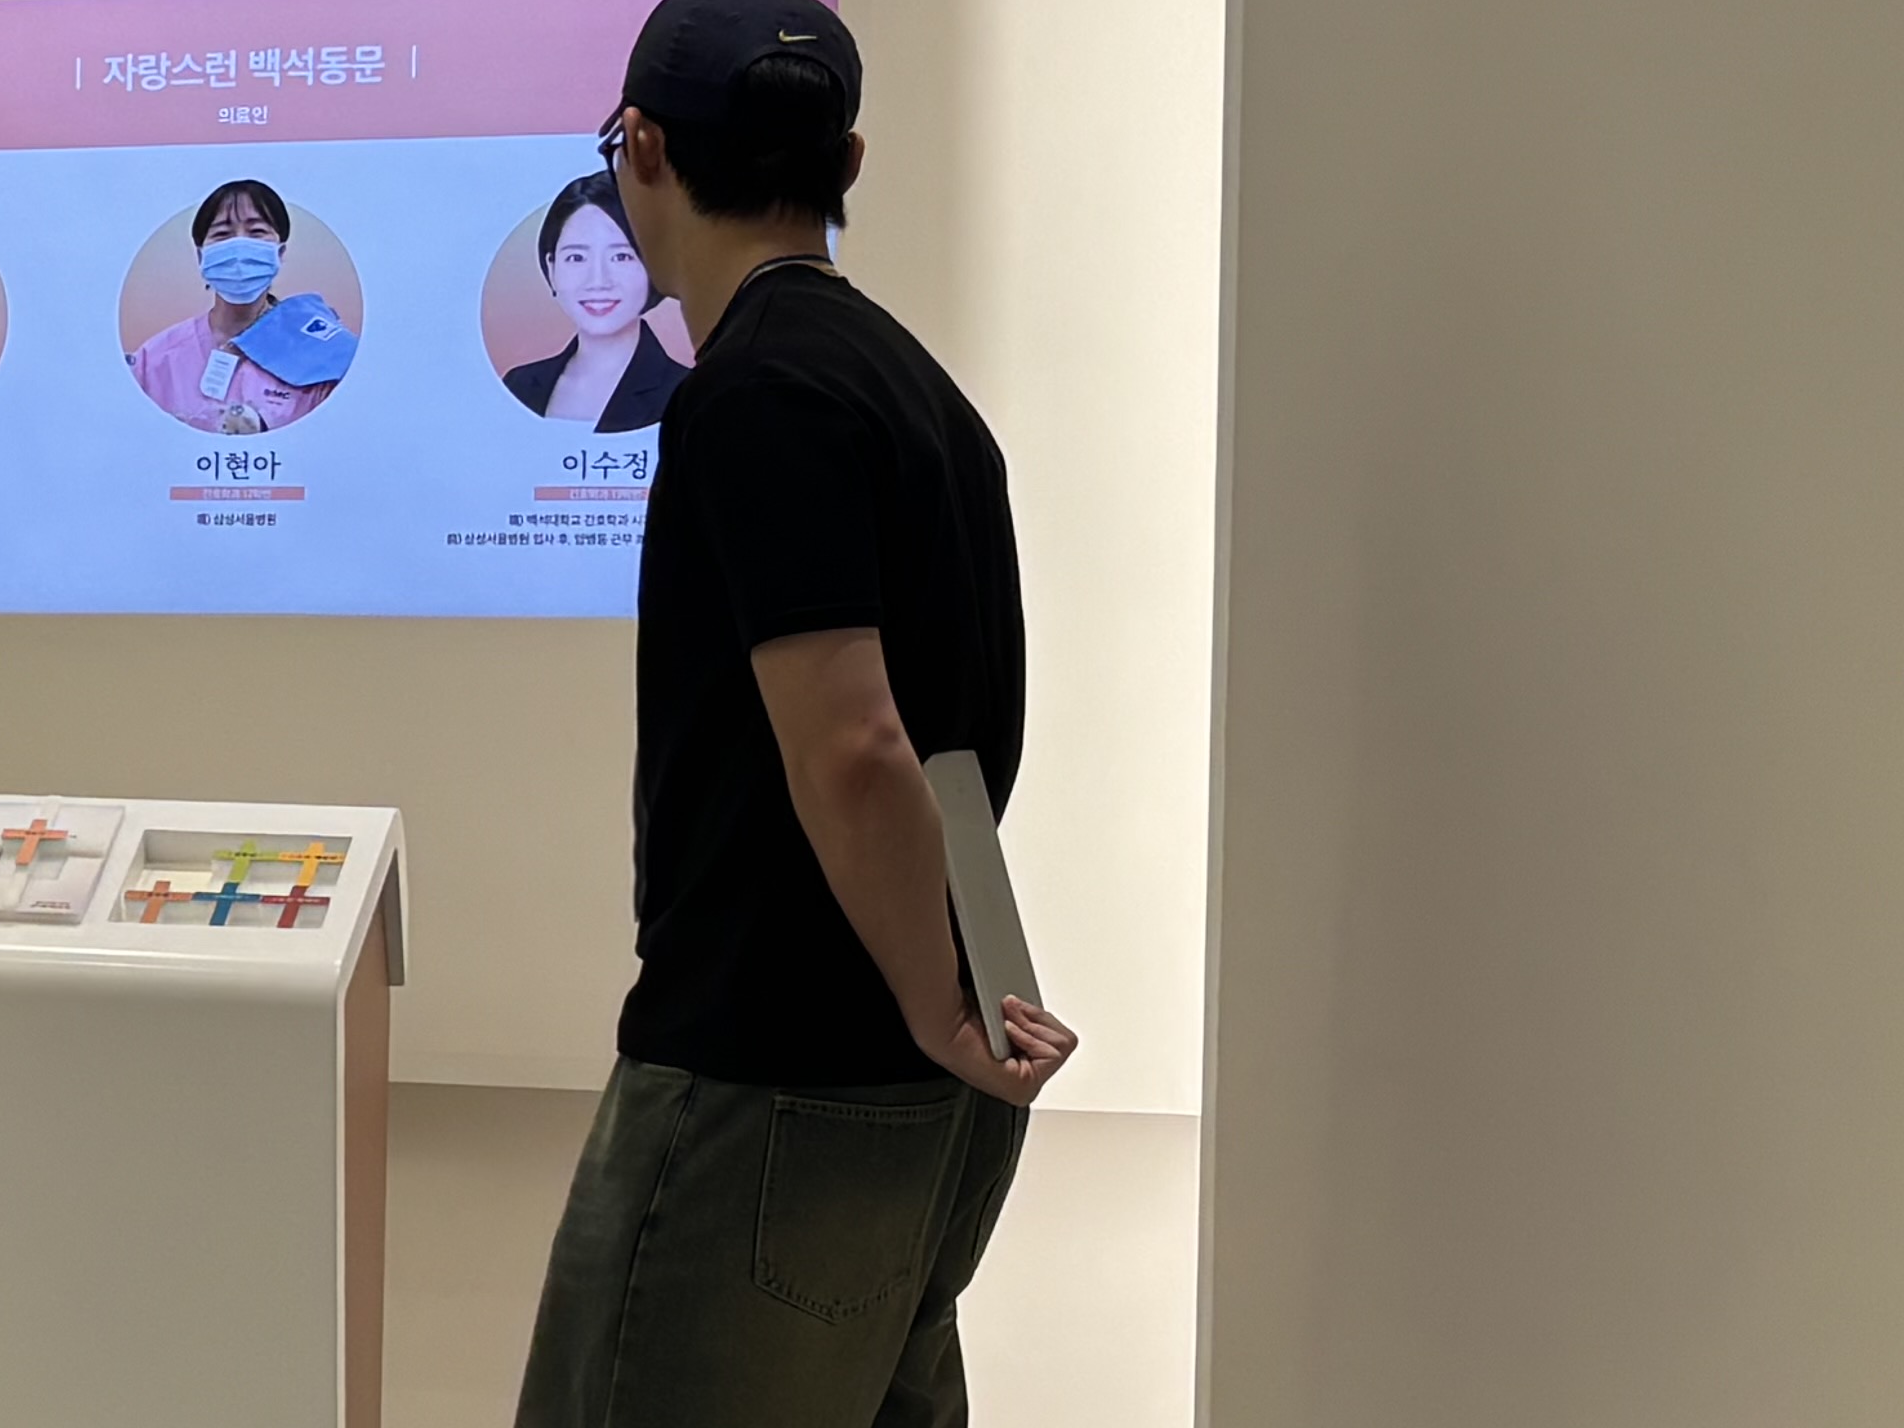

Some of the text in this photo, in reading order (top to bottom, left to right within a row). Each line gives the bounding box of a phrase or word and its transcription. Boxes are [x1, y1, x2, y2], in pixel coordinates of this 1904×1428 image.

[103, 45, 386, 92] 자랑스런 백석동문
[218, 105, 269, 125] 의료인
[196, 450, 282, 481] 이현아
[562, 449, 648, 480] 이수정
